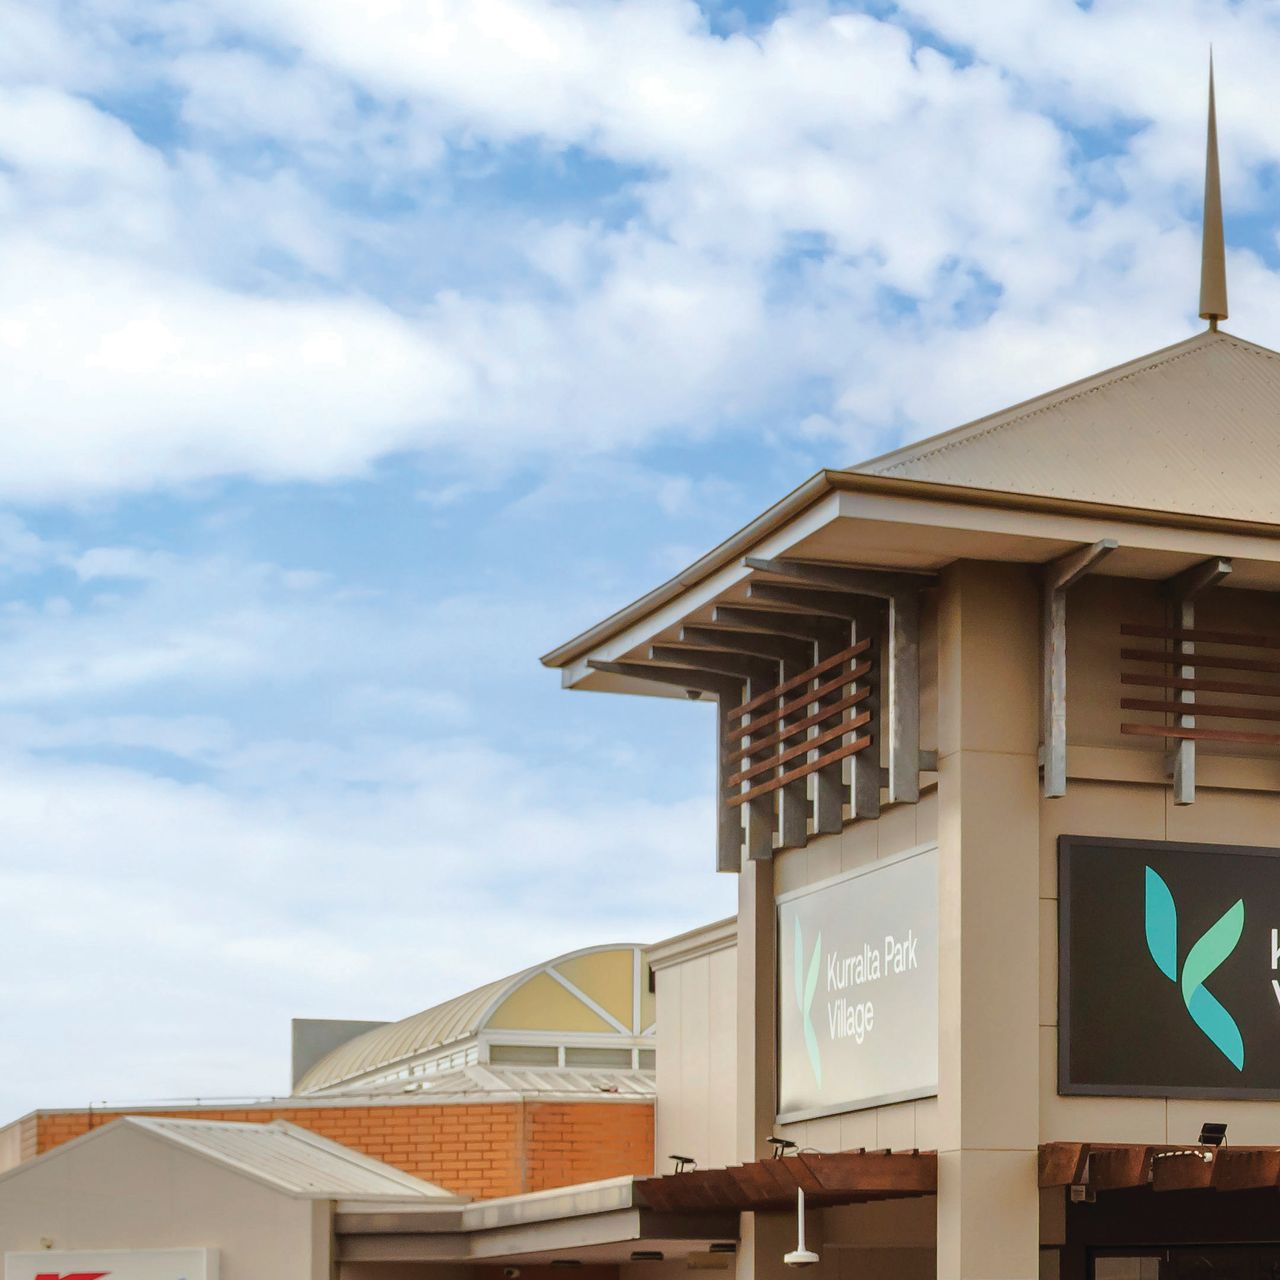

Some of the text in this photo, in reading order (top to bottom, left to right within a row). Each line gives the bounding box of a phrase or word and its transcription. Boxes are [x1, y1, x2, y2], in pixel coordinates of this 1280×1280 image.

[827, 930, 918, 992] Kurralta Park
[828, 998, 873, 1045] Village
